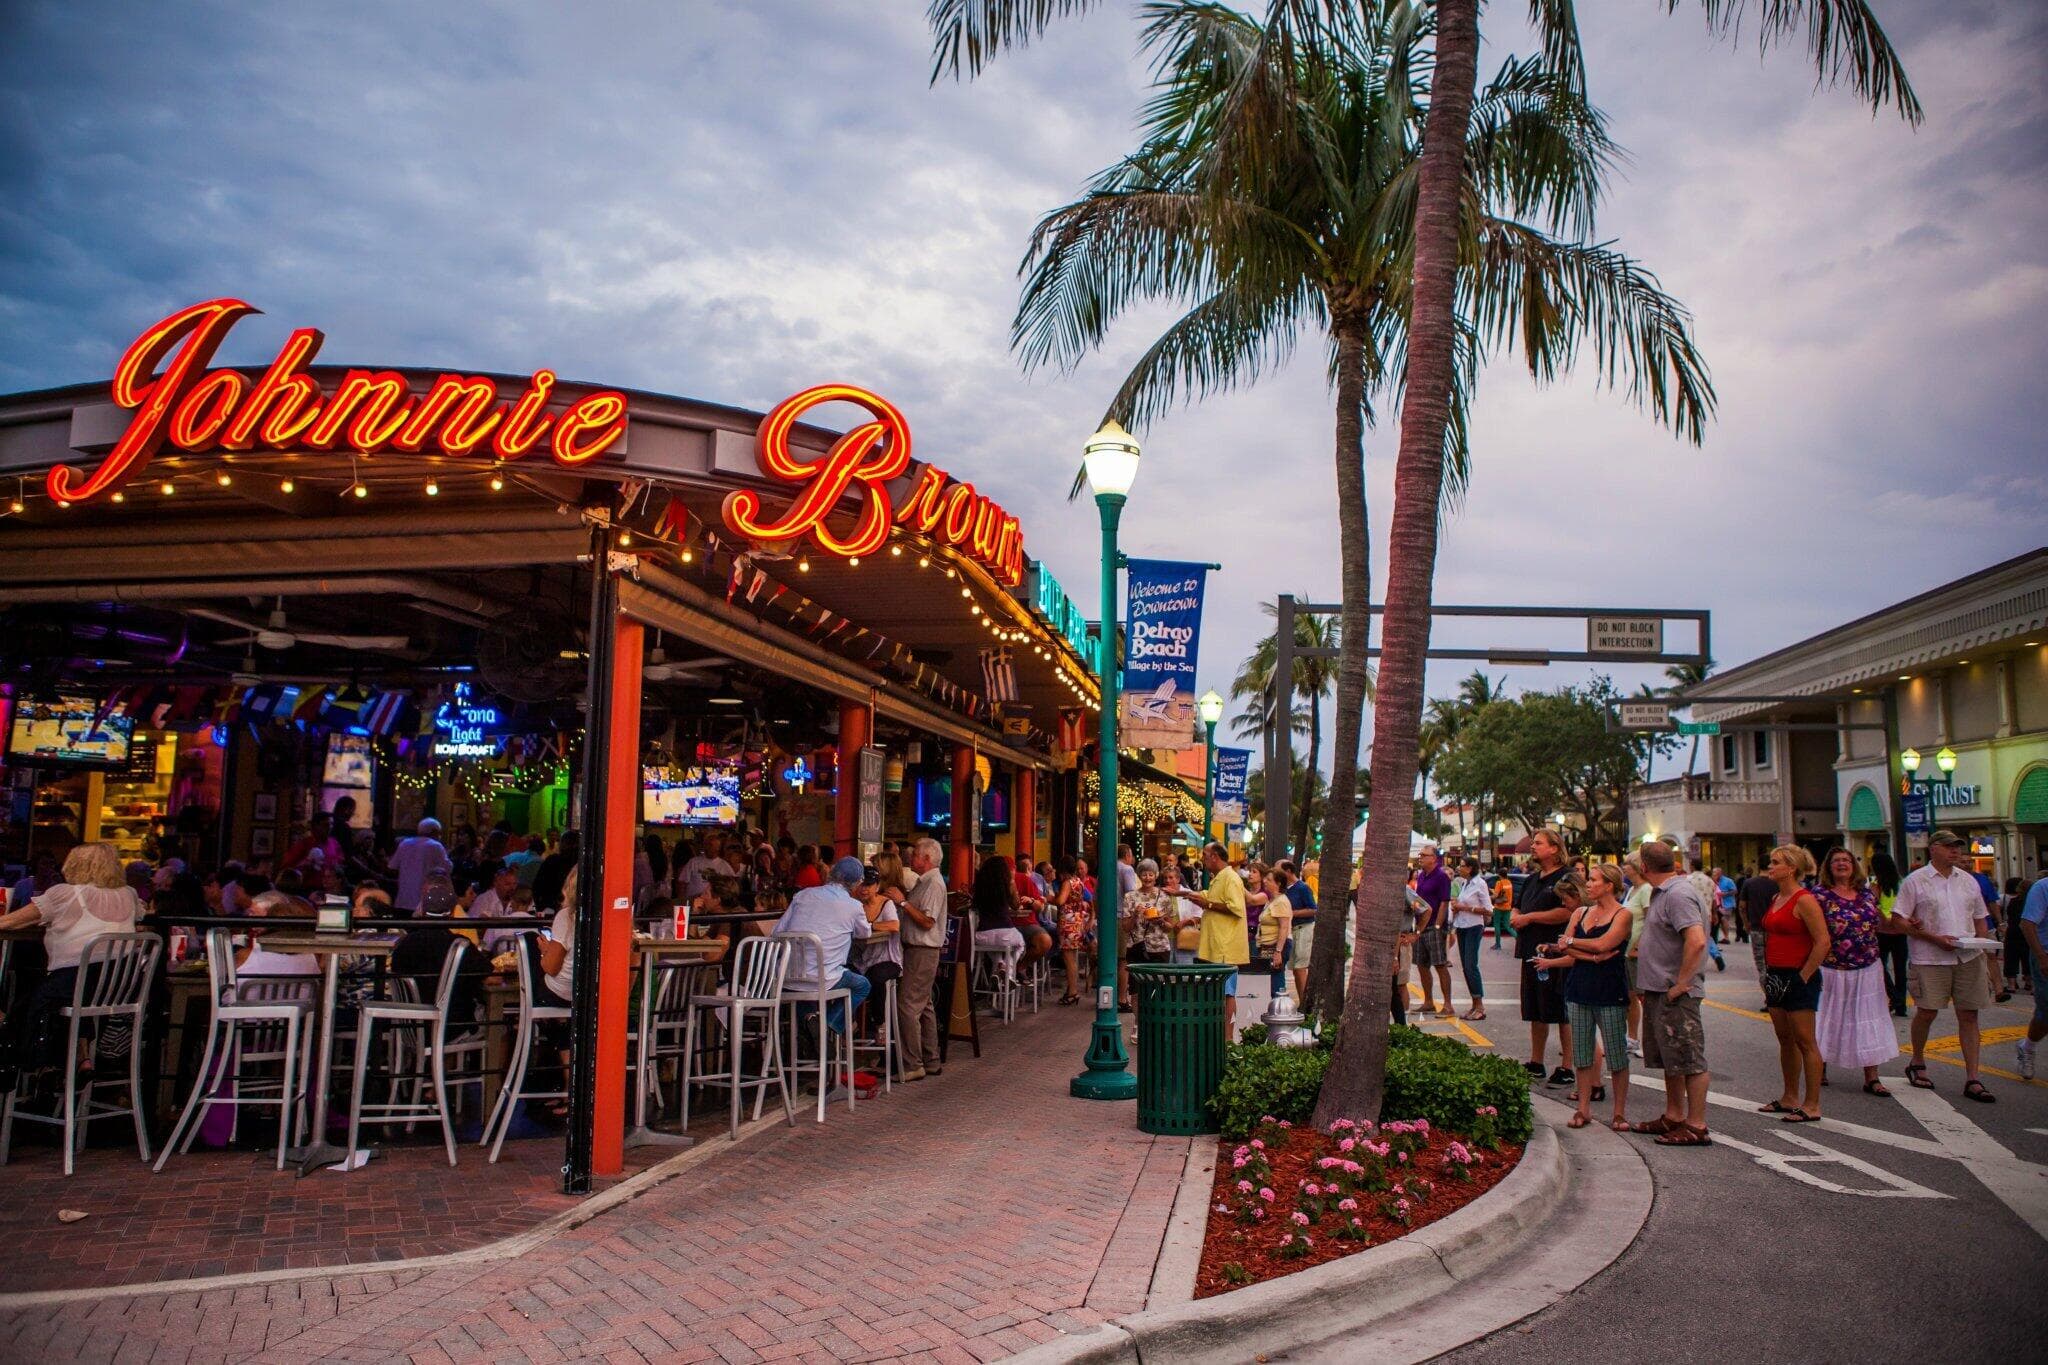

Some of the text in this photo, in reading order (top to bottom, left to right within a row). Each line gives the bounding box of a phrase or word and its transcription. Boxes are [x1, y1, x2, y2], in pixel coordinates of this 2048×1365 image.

[47, 298, 627, 500] Johnnie
[1129, 578, 1198, 599] Welcome to
[1132, 597, 1199, 618] Downtown
[1132, 621, 1193, 643] Delray
[1598, 622, 1655, 633] DO NOT BLOCK
[1131, 638, 1186, 659] Beach
[1599, 637, 1653, 648] INTERSECTION
[1152, 661, 1162, 672] by
[1164, 662, 1177, 671] the
[1179, 662, 1194, 673] Sea
